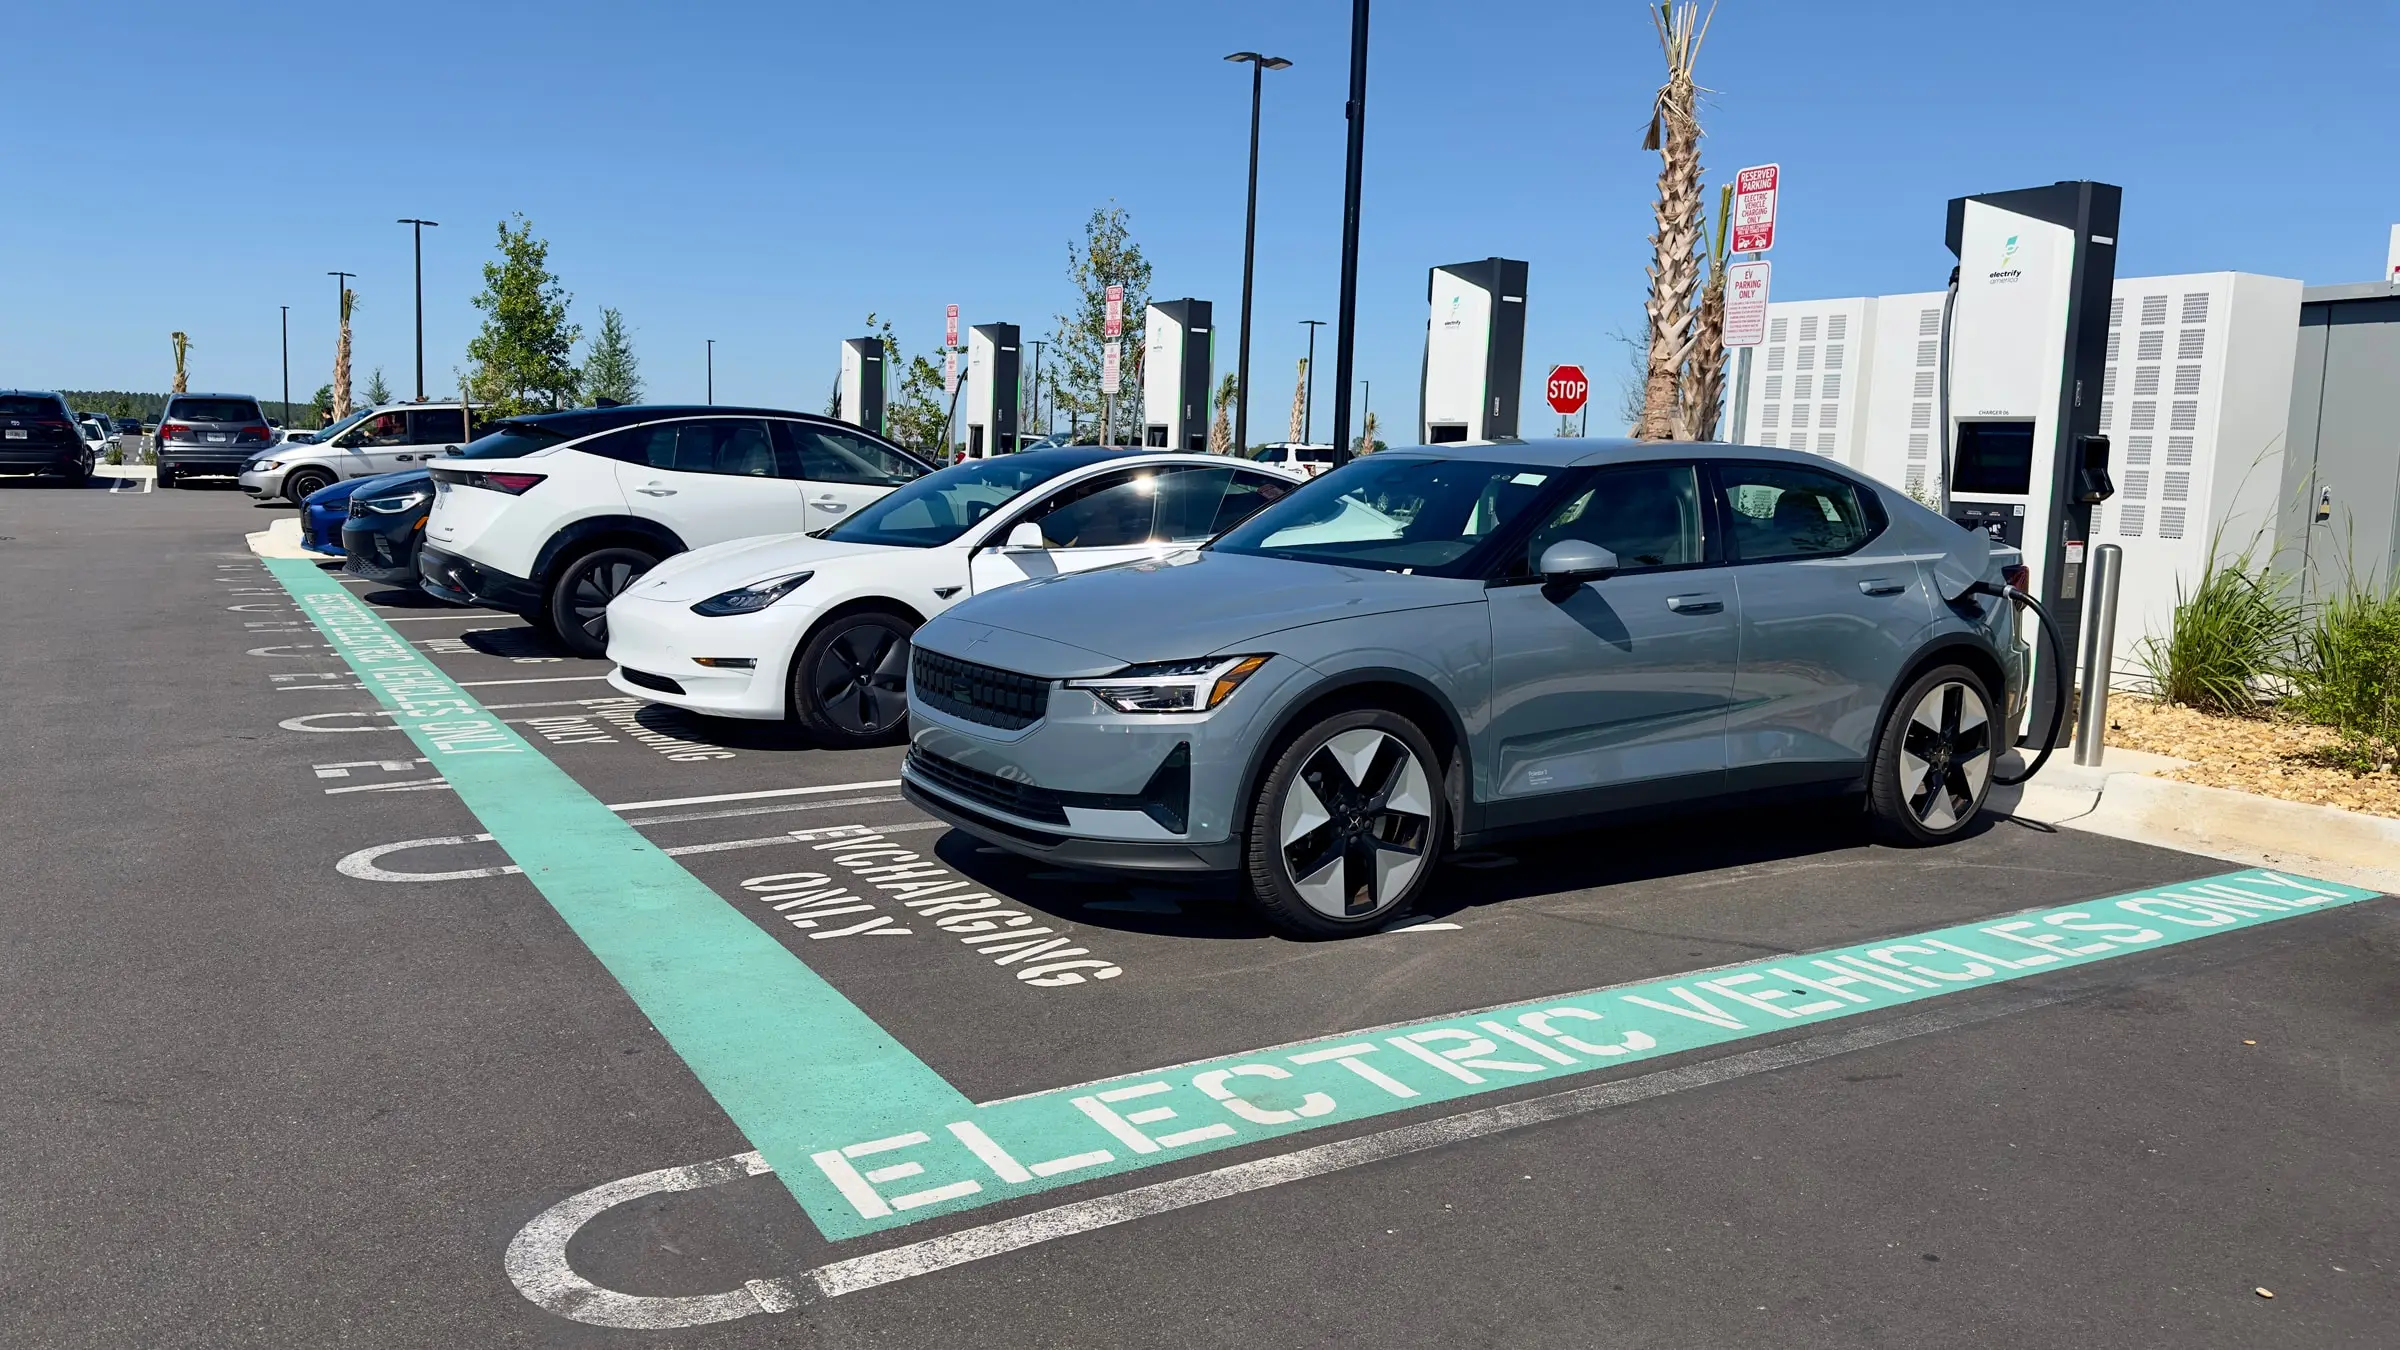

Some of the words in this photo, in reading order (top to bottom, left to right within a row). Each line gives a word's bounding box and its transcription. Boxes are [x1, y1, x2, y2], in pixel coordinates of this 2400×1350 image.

[1741, 168, 1775, 183] RESERVED
[1742, 178, 1772, 192] PARKING
[1744, 192, 1768, 203] ELECTRIC
[1745, 199, 1766, 210] VEHICLE
[1741, 207, 1768, 218] CHARGING
[1746, 216, 1761, 224] ONLY
[1744, 270, 1754, 280] EV
[1989, 269, 2022, 278] electrify
[1735, 279, 1762, 290] PARKING
[1739, 289, 1756, 299] ONLY
[1549, 380, 1586, 399] STOP
[368, 664, 477, 717] VEHICLES
[525, 717, 619, 744] ONLY
[419, 720, 524, 754] ONLY
[740, 872, 914, 940] ONLY
[810, 1007, 1656, 1219] ELECTRIC
[1622, 911, 2164, 1031] VEHICLES
[2116, 871, 2349, 927] ONLY
